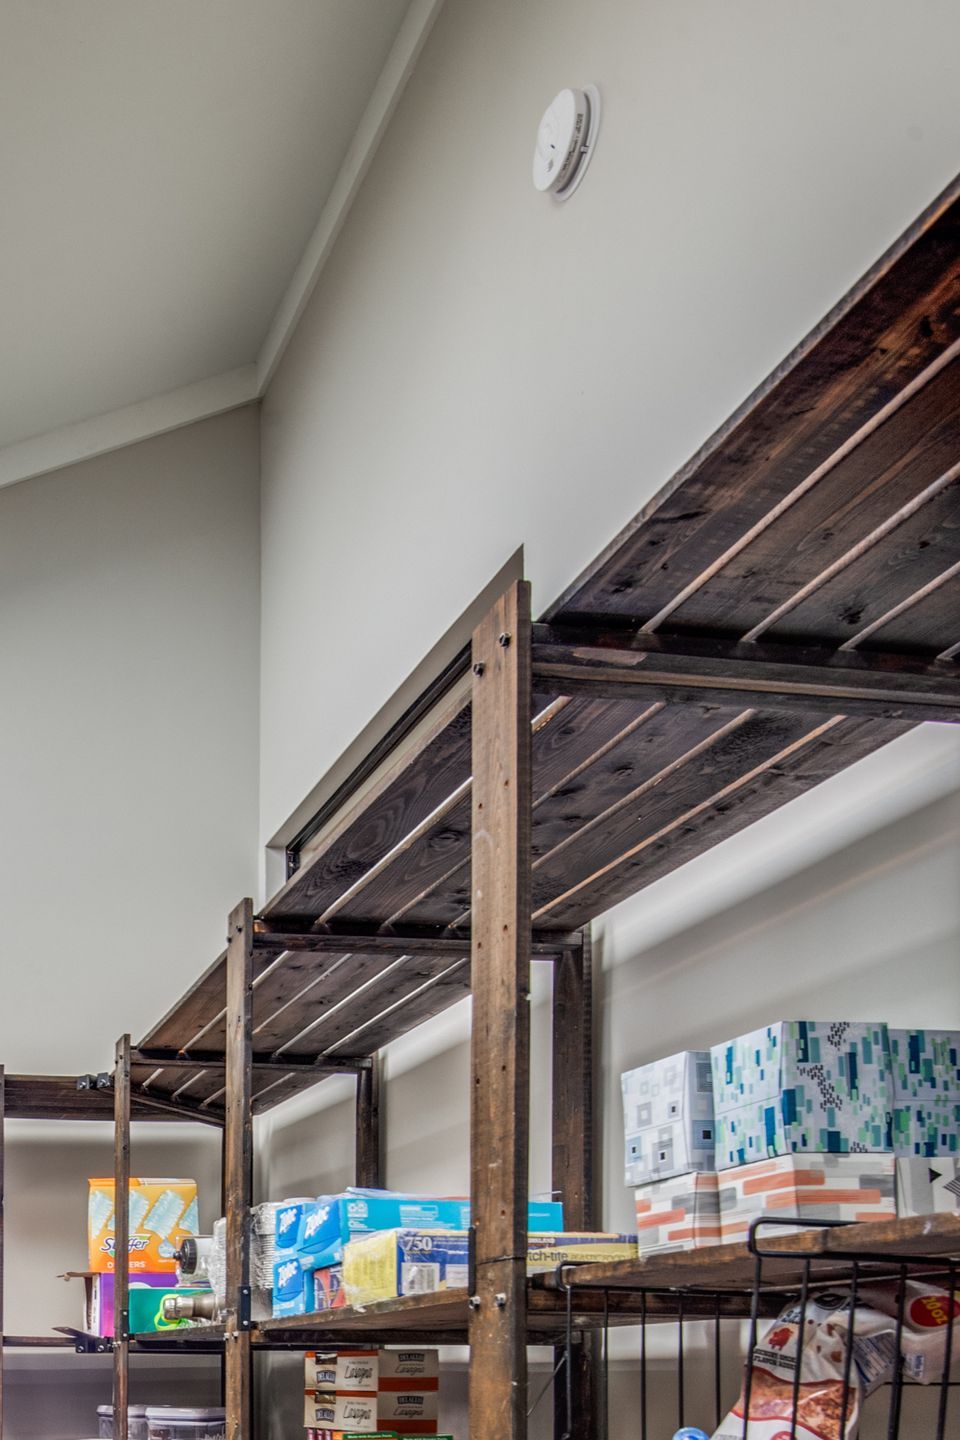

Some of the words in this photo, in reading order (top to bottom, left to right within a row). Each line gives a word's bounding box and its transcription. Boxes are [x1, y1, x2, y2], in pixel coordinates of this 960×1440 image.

[404, 1236, 433, 1251] 750
[344, 1365, 373, 1384] Lasagna
[343, 1405, 372, 1425] Lasagna
